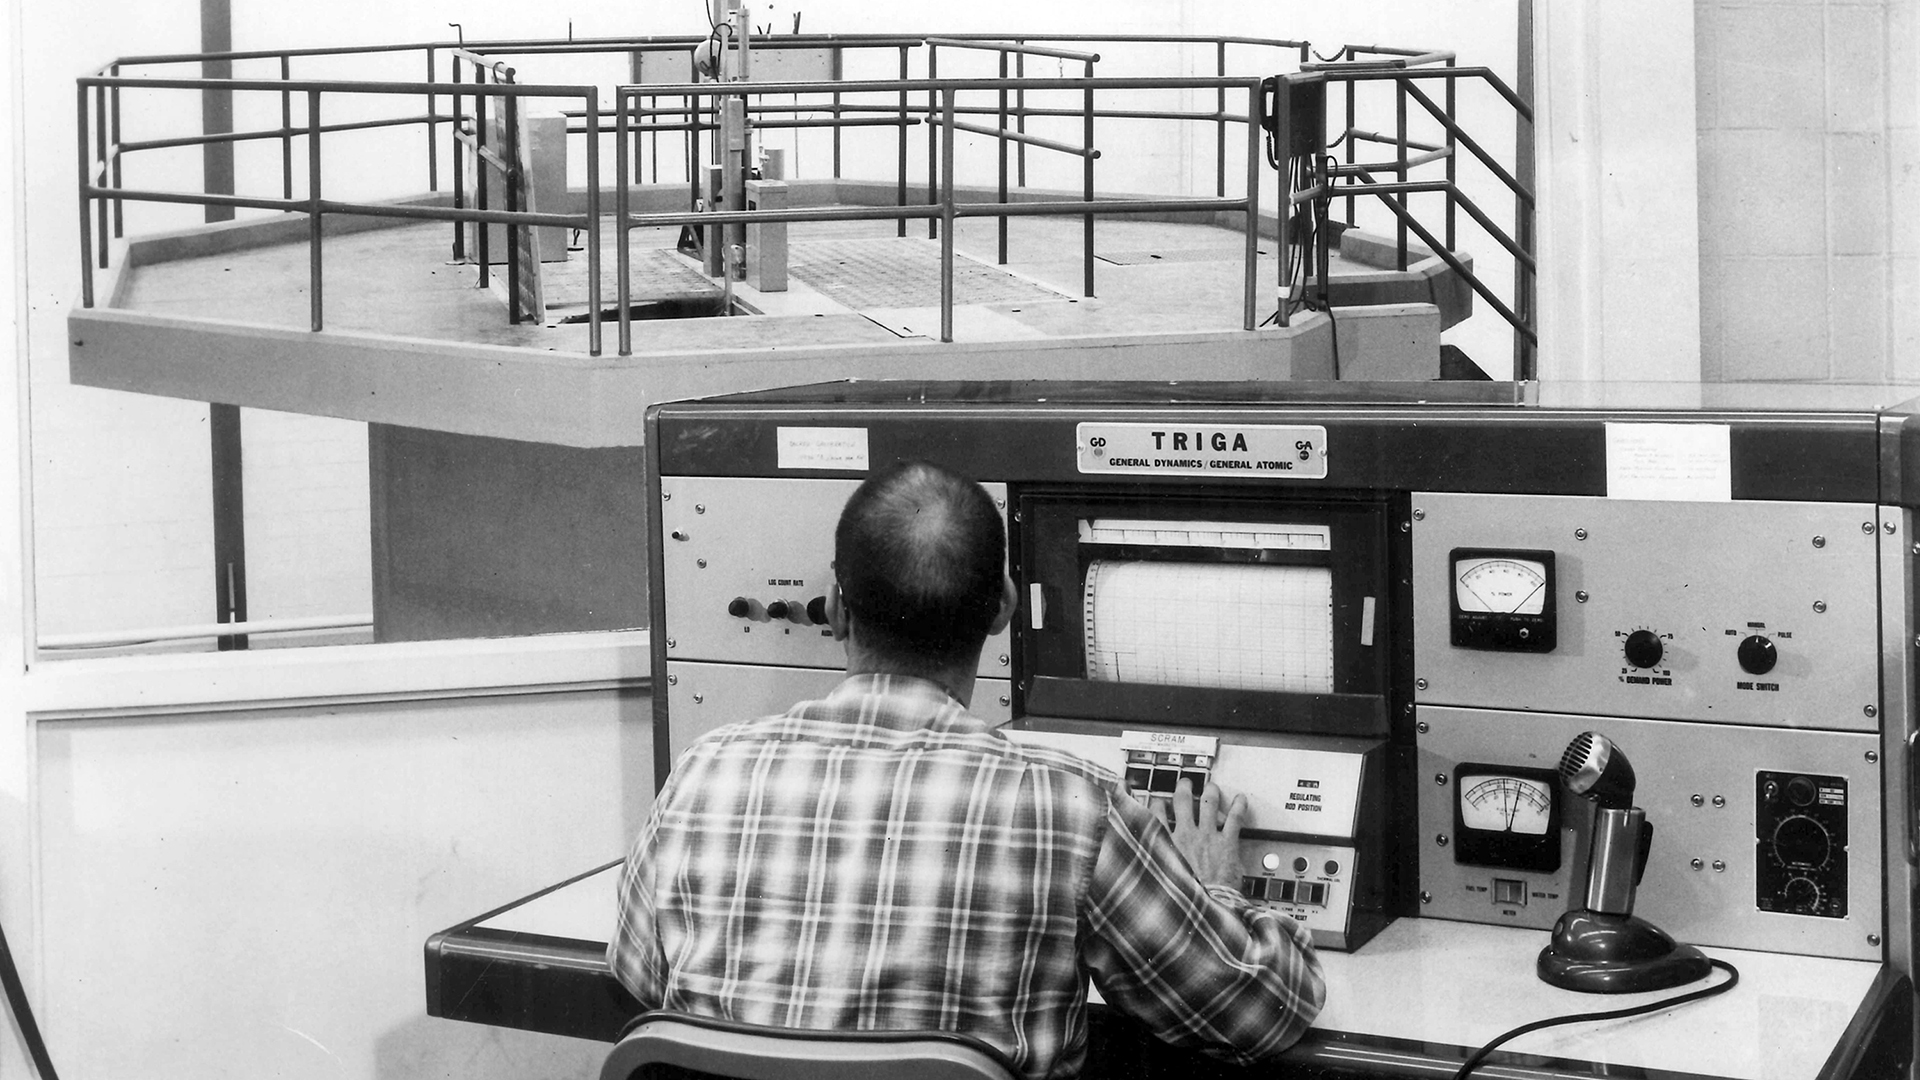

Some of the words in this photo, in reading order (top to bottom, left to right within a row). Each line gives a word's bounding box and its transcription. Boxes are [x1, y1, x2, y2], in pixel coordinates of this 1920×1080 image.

[1090, 437, 1106, 447] GD
[1151, 432, 1248, 452] TRIGA
[1295, 440, 1313, 450] GA
[1109, 457, 1151, 468] GENERAL
[1256, 460, 1293, 471] ATOMIC
[793, 579, 804, 587] RATE
[1777, 631, 1792, 639] PULSE
[1626, 675, 1650, 685] DEMAND
[1651, 676, 1673, 686] POWER
[1737, 681, 1754, 690] MODE
[1756, 682, 1780, 692] SWITCH
[1150, 733, 1186, 744] SCRAM
[1289, 792, 1321, 802] REGULATING
[1284, 802, 1296, 811] ROD
[1297, 803, 1322, 812] POSITION
